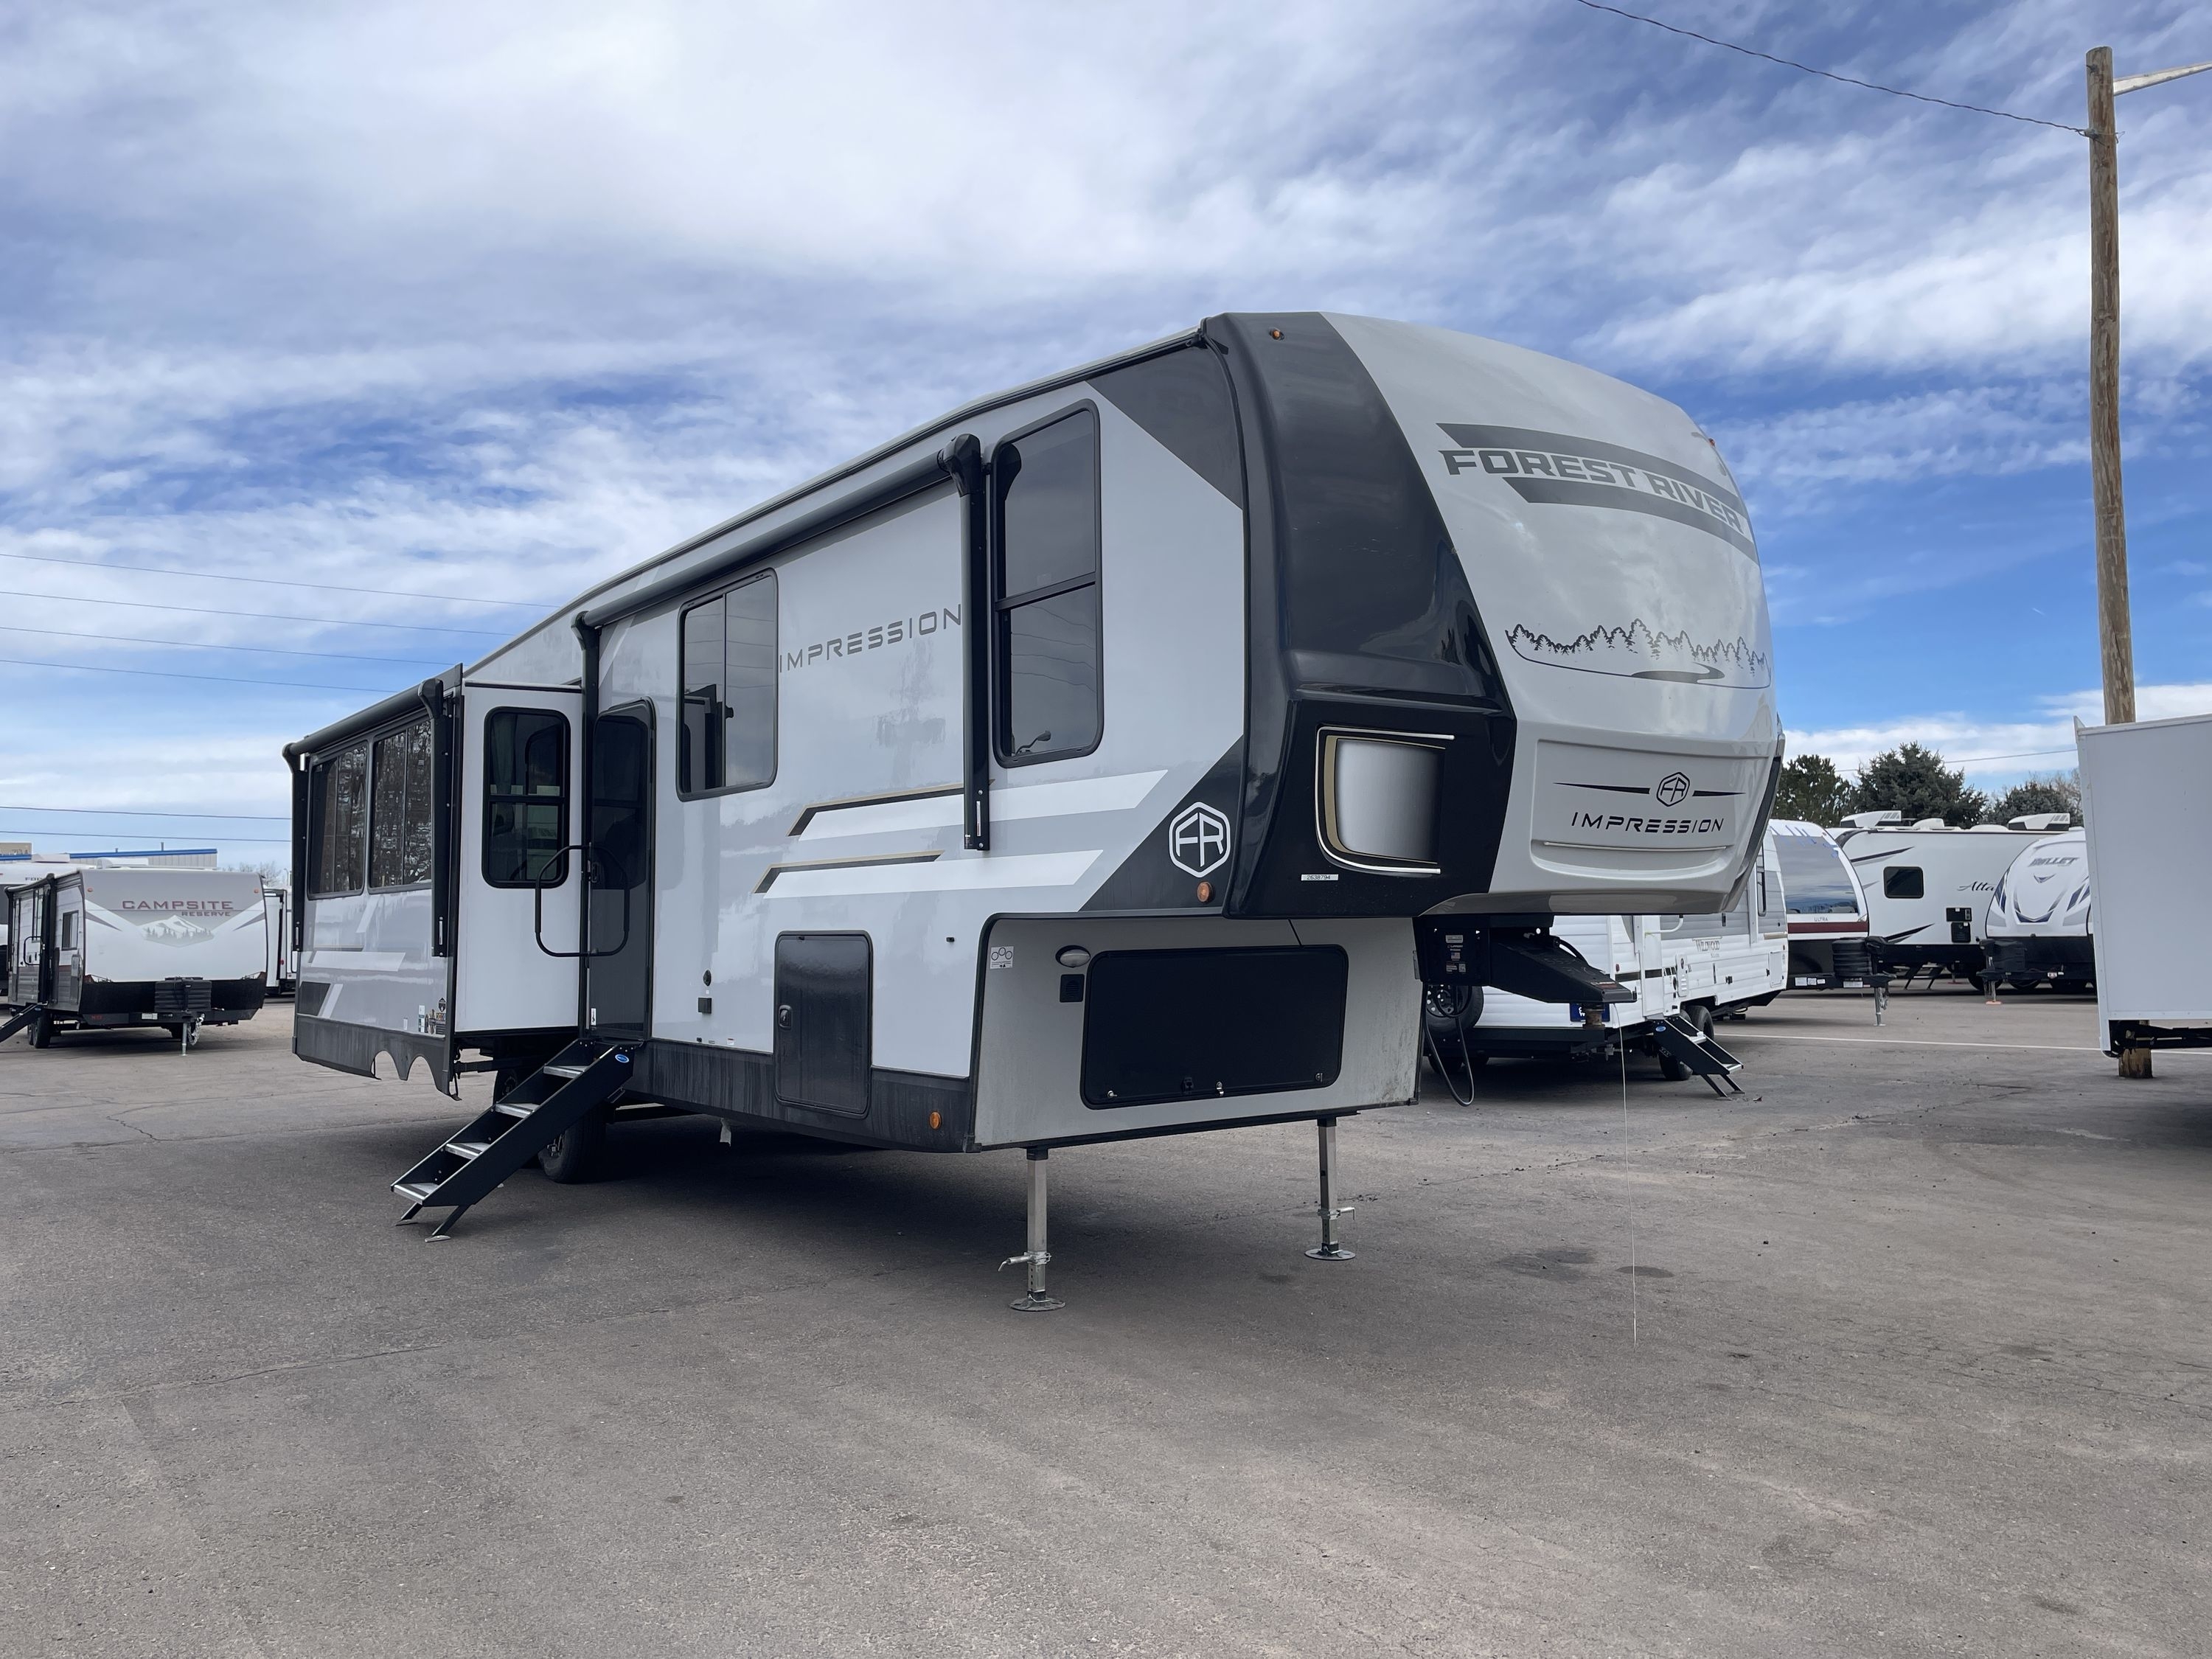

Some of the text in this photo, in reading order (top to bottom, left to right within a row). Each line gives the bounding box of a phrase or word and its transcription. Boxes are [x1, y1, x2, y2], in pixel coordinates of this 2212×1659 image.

[1439, 449, 1744, 534] FOREST RIVER
[779, 603, 961, 673] IMPRESSION
[1571, 812, 1724, 834] IMPRESSION
[122, 900, 234, 910] CAMPSITE
